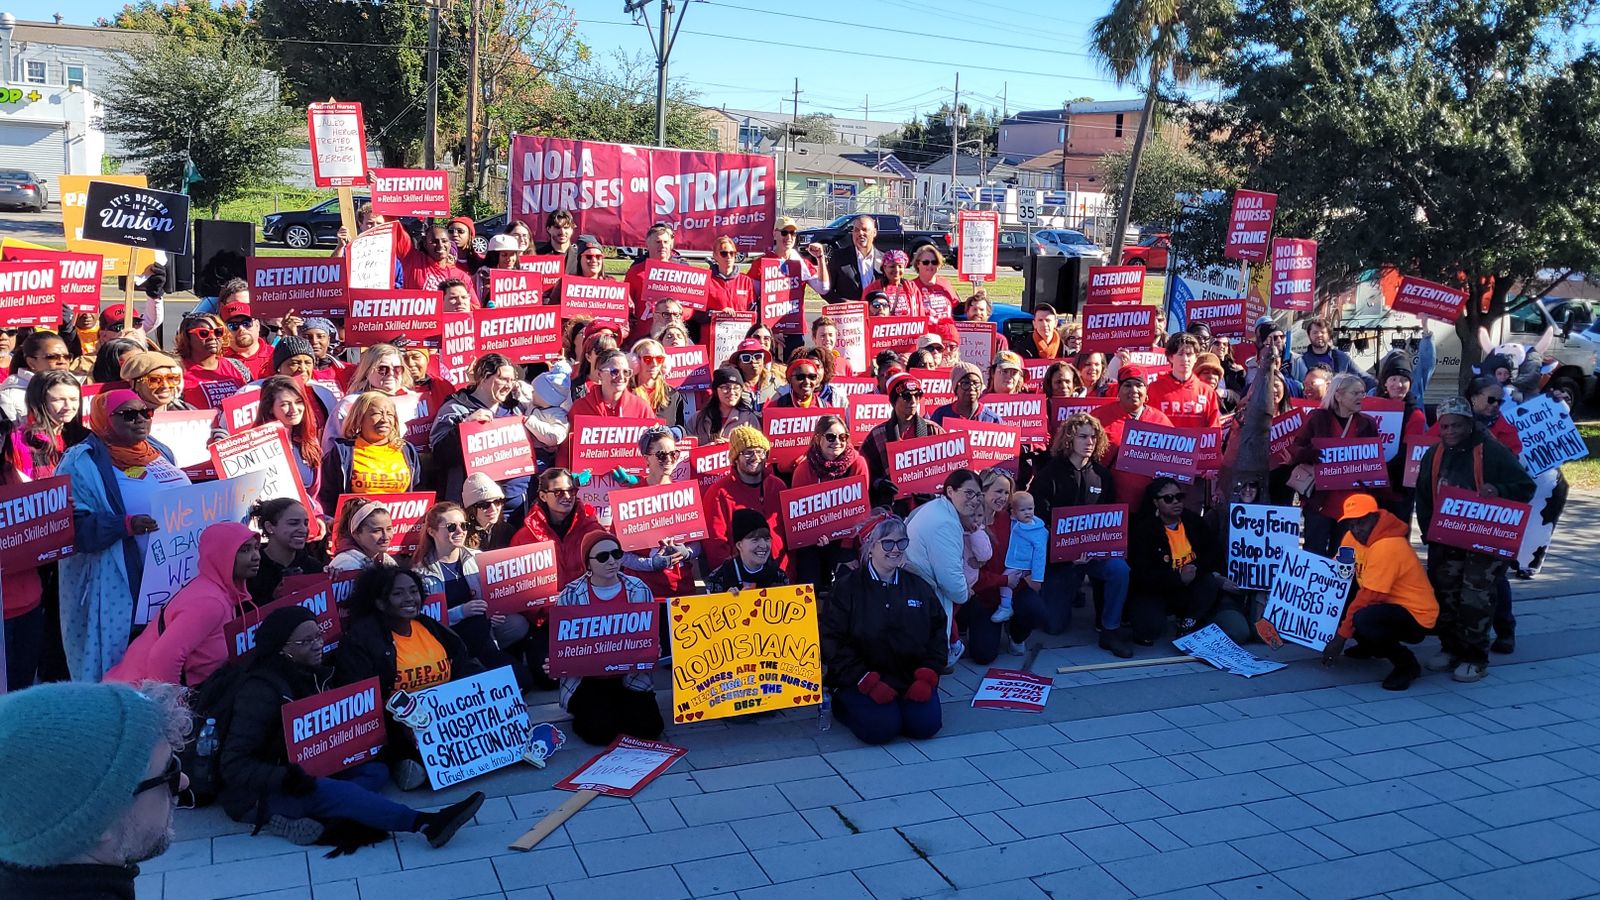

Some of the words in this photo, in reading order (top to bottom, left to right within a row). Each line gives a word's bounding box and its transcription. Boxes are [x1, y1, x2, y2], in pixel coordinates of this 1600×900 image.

[523, 149, 594, 182] NOLA
[376, 177, 442, 192] RETENTION
[521, 177, 624, 216] NURSES
[630, 177, 648, 193] ON
[655, 166, 767, 215] STRIKE
[110, 194, 130, 207] IT'S
[136, 194, 168, 215] BETTER
[1020, 206, 1034, 218] 35
[1237, 197, 1263, 208] NOLA
[100, 205, 174, 232] Union
[684, 218, 710, 230] Our
[713, 212, 766, 227] Patients
[1234, 210, 1271, 221] NURSES
[1230, 231, 1267, 244] STRIKE
[1276, 245, 1303, 258] NOLA
[1275, 258, 1312, 271] NURSES
[255, 264, 340, 288] RETENTION
[495, 276, 527, 292] NOLA
[649, 268, 707, 286] RETENTION
[765, 276, 799, 293] NURSES
[1092, 271, 1142, 286] RETENTION
[1278, 272, 1287, 280] ON
[289, 290, 314, 300] Skilled
[316, 288, 342, 298] Nurses
[566, 284, 625, 300] RETENTION
[1274, 280, 1312, 295] STRIKE
[1403, 284, 1462, 306] RETENTION
[26, 294, 56, 305] Nurses
[352, 298, 436, 318] RETENTION
[495, 290, 538, 308] NURSES
[765, 300, 800, 318] STRIKE
[1087, 312, 1150, 330] RETENTION
[1190, 304, 1242, 320] RETENTION
[384, 320, 410, 330] Skilled
[412, 320, 437, 330] Nurses
[480, 312, 555, 338] RETENTION
[872, 322, 925, 338] RETENTION
[510, 337, 532, 348] Skilled
[534, 334, 556, 345] Nurses
[452, 355, 464, 366] ON
[1506, 414, 1530, 432] You
[1530, 402, 1554, 424] can't
[216, 435, 250, 452] National
[250, 426, 278, 440] Nurses
[468, 424, 526, 454] RETENTION
[774, 436, 796, 448] Retain
[1126, 429, 1196, 453] RETENTION
[1522, 430, 1546, 448] stop
[1546, 420, 1566, 436] the
[262, 442, 282, 460] LIE
[586, 448, 608, 458] Retain
[610, 448, 634, 458] Skilled
[896, 438, 966, 470] RETENTION
[994, 452, 1014, 460] Nurses
[1129, 450, 1150, 460] Retain
[1150, 452, 1172, 462] Skilled
[1172, 455, 1193, 466] Nurses
[903, 471, 924, 482] Retain
[924, 463, 946, 478] Skilled
[1363, 463, 1382, 472] Nurses
[618, 488, 694, 520] RETENTION
[789, 482, 862, 519] RETENTION
[164, 497, 193, 534] We
[627, 522, 650, 534] Retain
[651, 517, 674, 529] Skilled
[676, 510, 698, 523] Nurses
[798, 518, 819, 532] Retain
[820, 511, 842, 524] Skilled
[843, 504, 866, 517] Nurses
[1056, 510, 1123, 534] RETENTION
[1230, 505, 1264, 536] Greg
[1440, 498, 1524, 526] RETENTION
[24, 525, 47, 542] Skilled
[49, 516, 70, 532] Nurses
[1060, 536, 1080, 547] Retain
[1080, 534, 1100, 544] Skilled
[1101, 532, 1122, 542] Nurses
[1442, 519, 1466, 532] Retain
[1467, 522, 1492, 535] Skilled
[1494, 528, 1518, 540] Nurses
[1231, 537, 1264, 562] stop
[169, 556, 194, 586] WE
[486, 548, 552, 584] RETENTION
[1282, 552, 1310, 578] Not
[1309, 572, 1348, 600] paying
[494, 585, 516, 598] Retain
[516, 578, 536, 592] Skilled
[537, 573, 558, 586] Nurses
[1273, 578, 1324, 614] NURSES
[1326, 602, 1338, 618] is
[558, 611, 652, 641] RETENTION
[674, 603, 742, 649] STEP
[762, 599, 806, 624] UP
[1270, 604, 1319, 640] KILLING
[1318, 631, 1335, 644] us
[564, 645, 592, 658] Retain
[594, 640, 622, 654] Skilled
[624, 637, 652, 651] Nurses
[674, 632, 820, 690] LOUISIANA
[736, 664, 757, 676] ARE
[760, 660, 778, 670] THE
[780, 662, 814, 678] HEART
[395, 665, 432, 682] STEP
[678, 701, 690, 713] IN
[759, 672, 778, 682] OUR
[780, 674, 820, 692] NURSES
[709, 688, 758, 708] DESERVES
[760, 683, 782, 694] THE
[997, 681, 1045, 690] Nurses
[428, 695, 458, 720] You
[458, 682, 485, 710] can't
[490, 684, 514, 704] run
[293, 688, 375, 744] RETENTION
[422, 732, 434, 746] a
[437, 706, 504, 742] HOSPITAL
[505, 701, 527, 720] with
[304, 738, 328, 760] Retain
[329, 727, 354, 750] Skilled
[355, 718, 380, 738] Nurses
[427, 754, 438, 767] a
[438, 733, 504, 768] SKELETON
[502, 720, 531, 750] CREW
[621, 736, 654, 748] National
[480, 761, 490, 772] we
